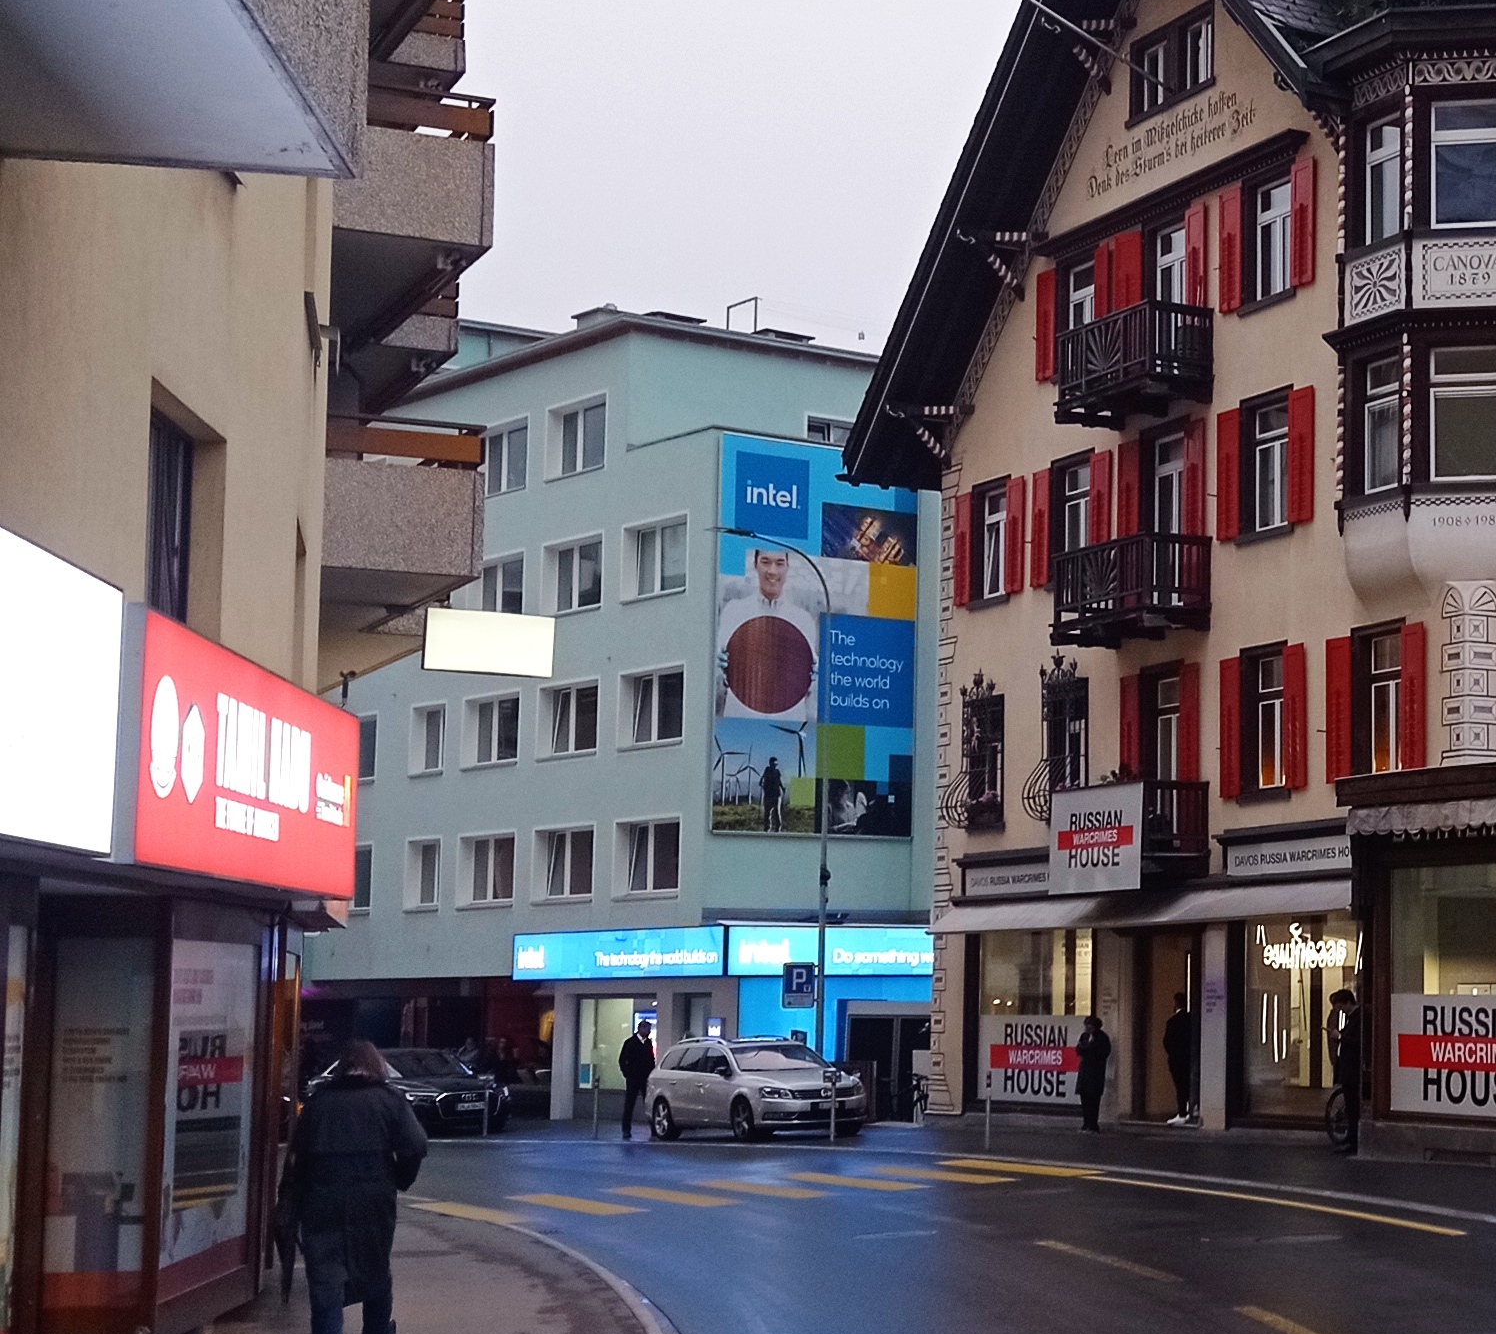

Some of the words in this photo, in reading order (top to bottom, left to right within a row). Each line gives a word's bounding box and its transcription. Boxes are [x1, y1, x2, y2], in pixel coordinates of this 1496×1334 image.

[1448, 271, 1491, 285] 1879
[1432, 515, 1462, 527] 1908
[830, 630, 856, 646] The
[831, 652, 904, 673] technology
[831, 671, 852, 686] the
[855, 675, 890, 689] world
[831, 692, 869, 708] builds
[872, 698, 890, 709] on
[1069, 810, 1123, 831] RUSSIAN
[1072, 829, 1118, 846] WARCRIMES
[1068, 846, 1120, 868] HOUSE
[1234, 853, 1259, 867] DAVOS
[1260, 852, 1288, 865] RUSSIA
[1289, 847, 1337, 863] WARCRIMES
[1338, 845, 1351, 858] HO
[832, 948, 853, 964] Do
[854, 948, 920, 967] something
[792, 969, 807, 991] P
[1004, 1022, 1068, 1047] RUSSIAN
[1008, 1049, 1063, 1066] WARCRIMES
[1004, 1068, 1067, 1098] HOUSE
